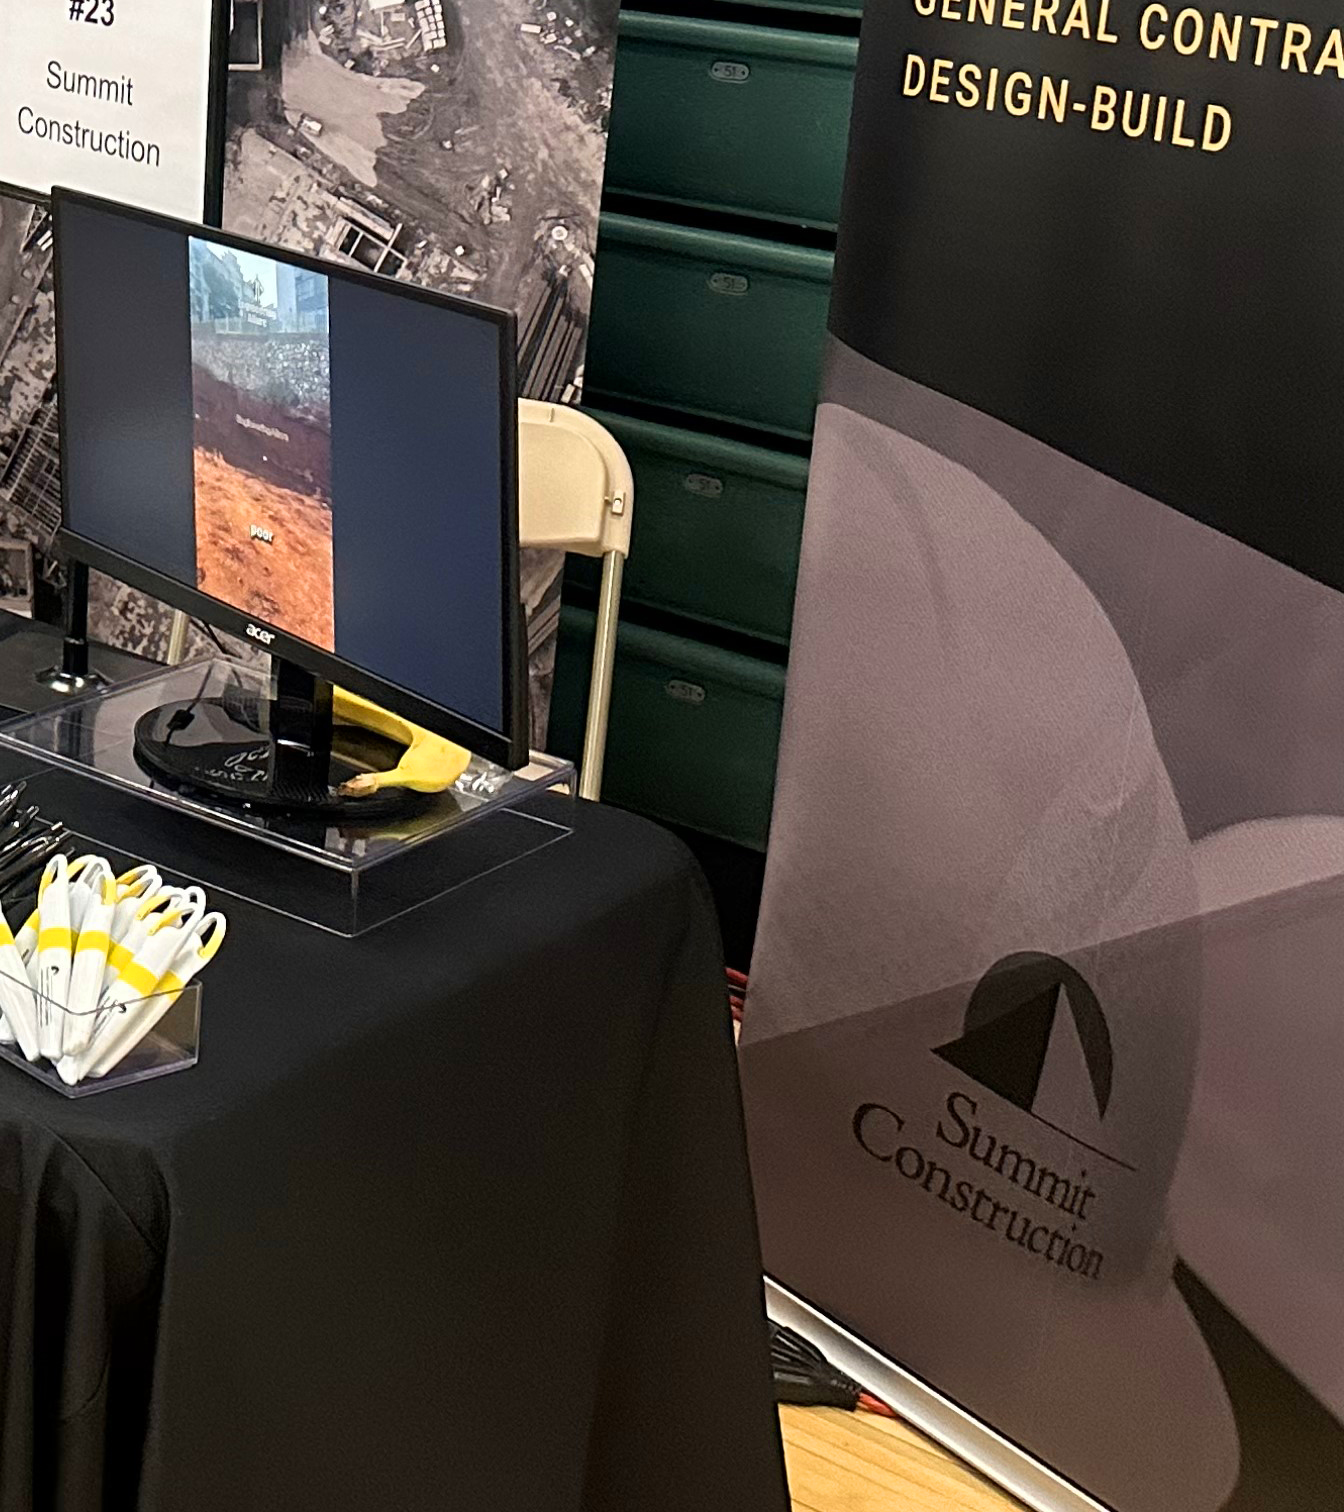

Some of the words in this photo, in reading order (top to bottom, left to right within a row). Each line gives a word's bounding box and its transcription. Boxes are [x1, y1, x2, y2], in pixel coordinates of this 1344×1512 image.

[723, 65, 737, 80] 51
[1138, 1, 1344, 80] CONTRA
[45, 59, 135, 107] Summit
[902, 53, 1233, 154] DESIGN-BUILD
[17, 105, 161, 168] Construction
[245, 622, 276, 646] acer
[851, 1102, 1105, 1281] Construction
[935, 1091, 1097, 1221] Summit
